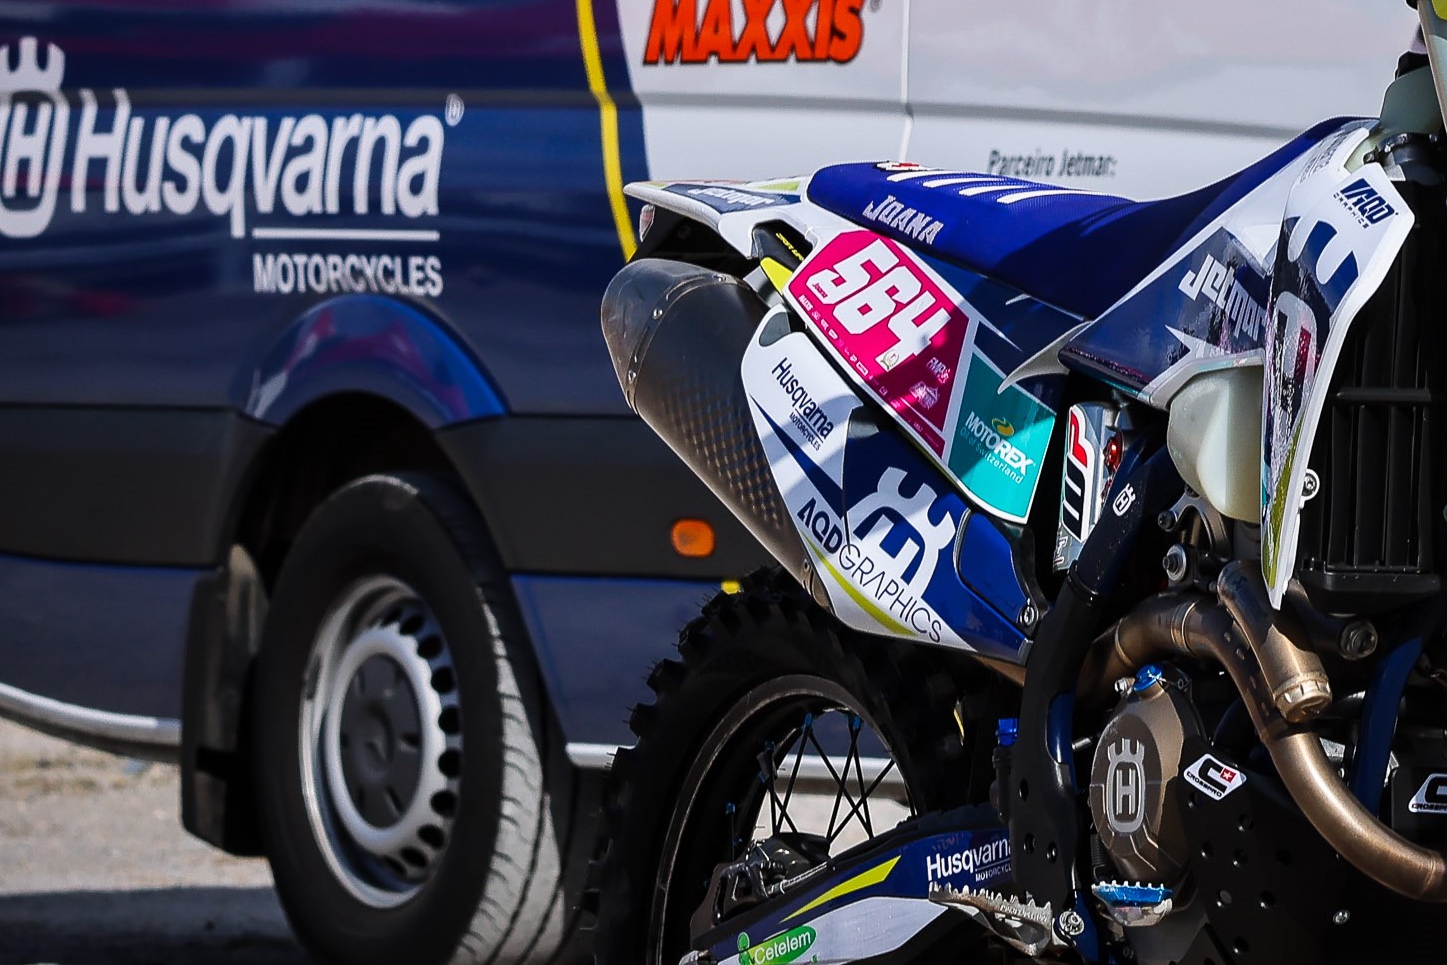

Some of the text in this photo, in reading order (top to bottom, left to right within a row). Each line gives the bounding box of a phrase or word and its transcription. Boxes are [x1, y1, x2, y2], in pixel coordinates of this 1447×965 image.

[70, 88, 446, 239] Husqvarna
[987, 148, 1055, 176] Parceiro
[252, 253, 444, 297] MOTORCYCLES
[805, 237, 952, 373] 564
[771, 356, 835, 441] Husqvarna
[788, 411, 822, 452] MOTORCYCLES
[964, 410, 1035, 476] MOTOREX
[1186, 770, 1223, 799] CROSSPRO
[926, 837, 1012, 882] Husqvarn
[752, 929, 812, 965] Cetelem
